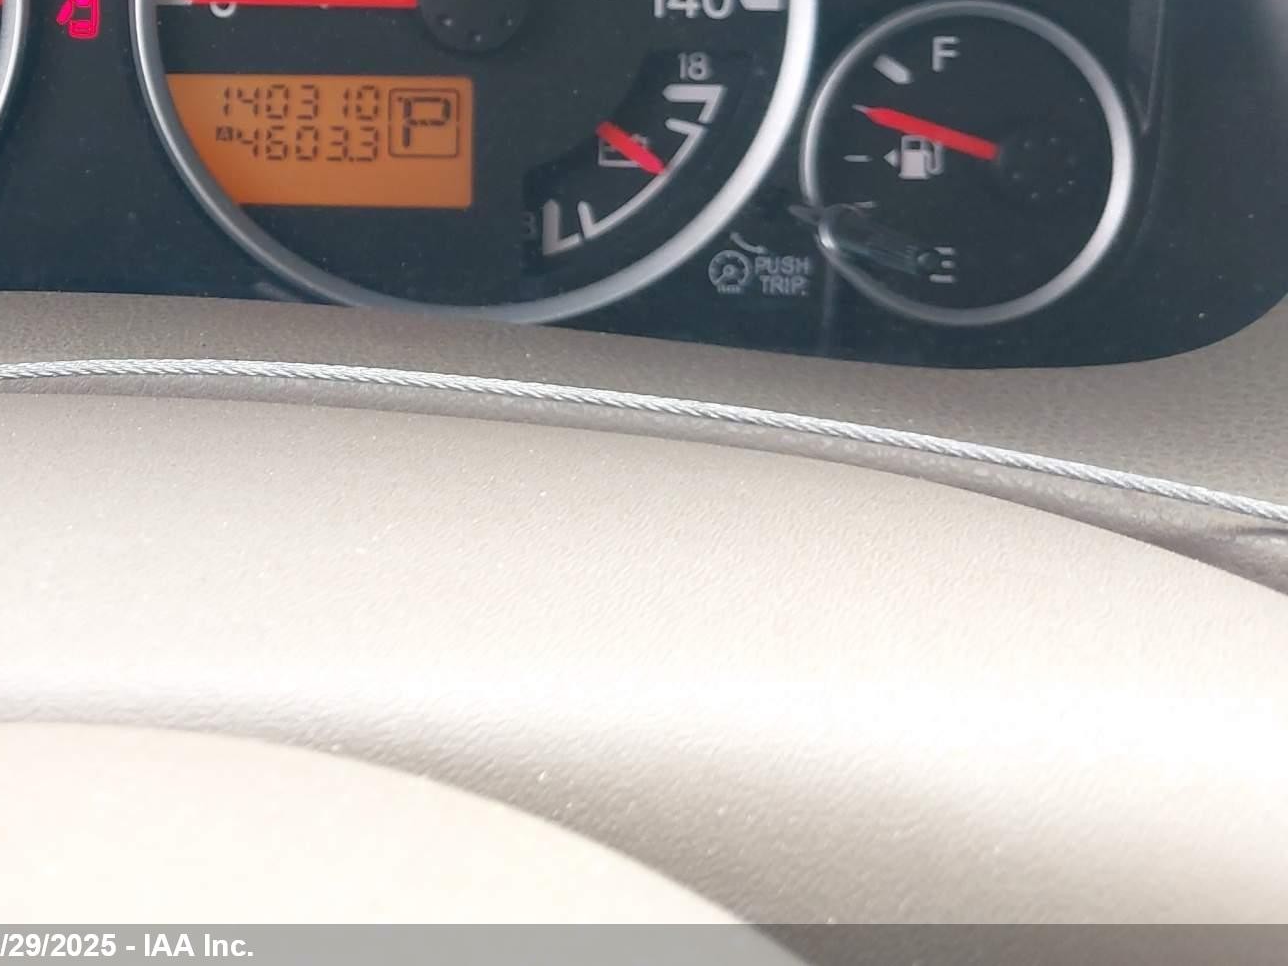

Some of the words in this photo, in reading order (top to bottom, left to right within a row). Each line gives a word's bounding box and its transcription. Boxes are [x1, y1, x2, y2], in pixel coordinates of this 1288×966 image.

[679, 52, 711, 81] 18
[932, 36, 959, 72] F
[223, 84, 379, 120] 140310
[398, 96, 451, 148] P
[754, 256, 809, 275] PUSH
